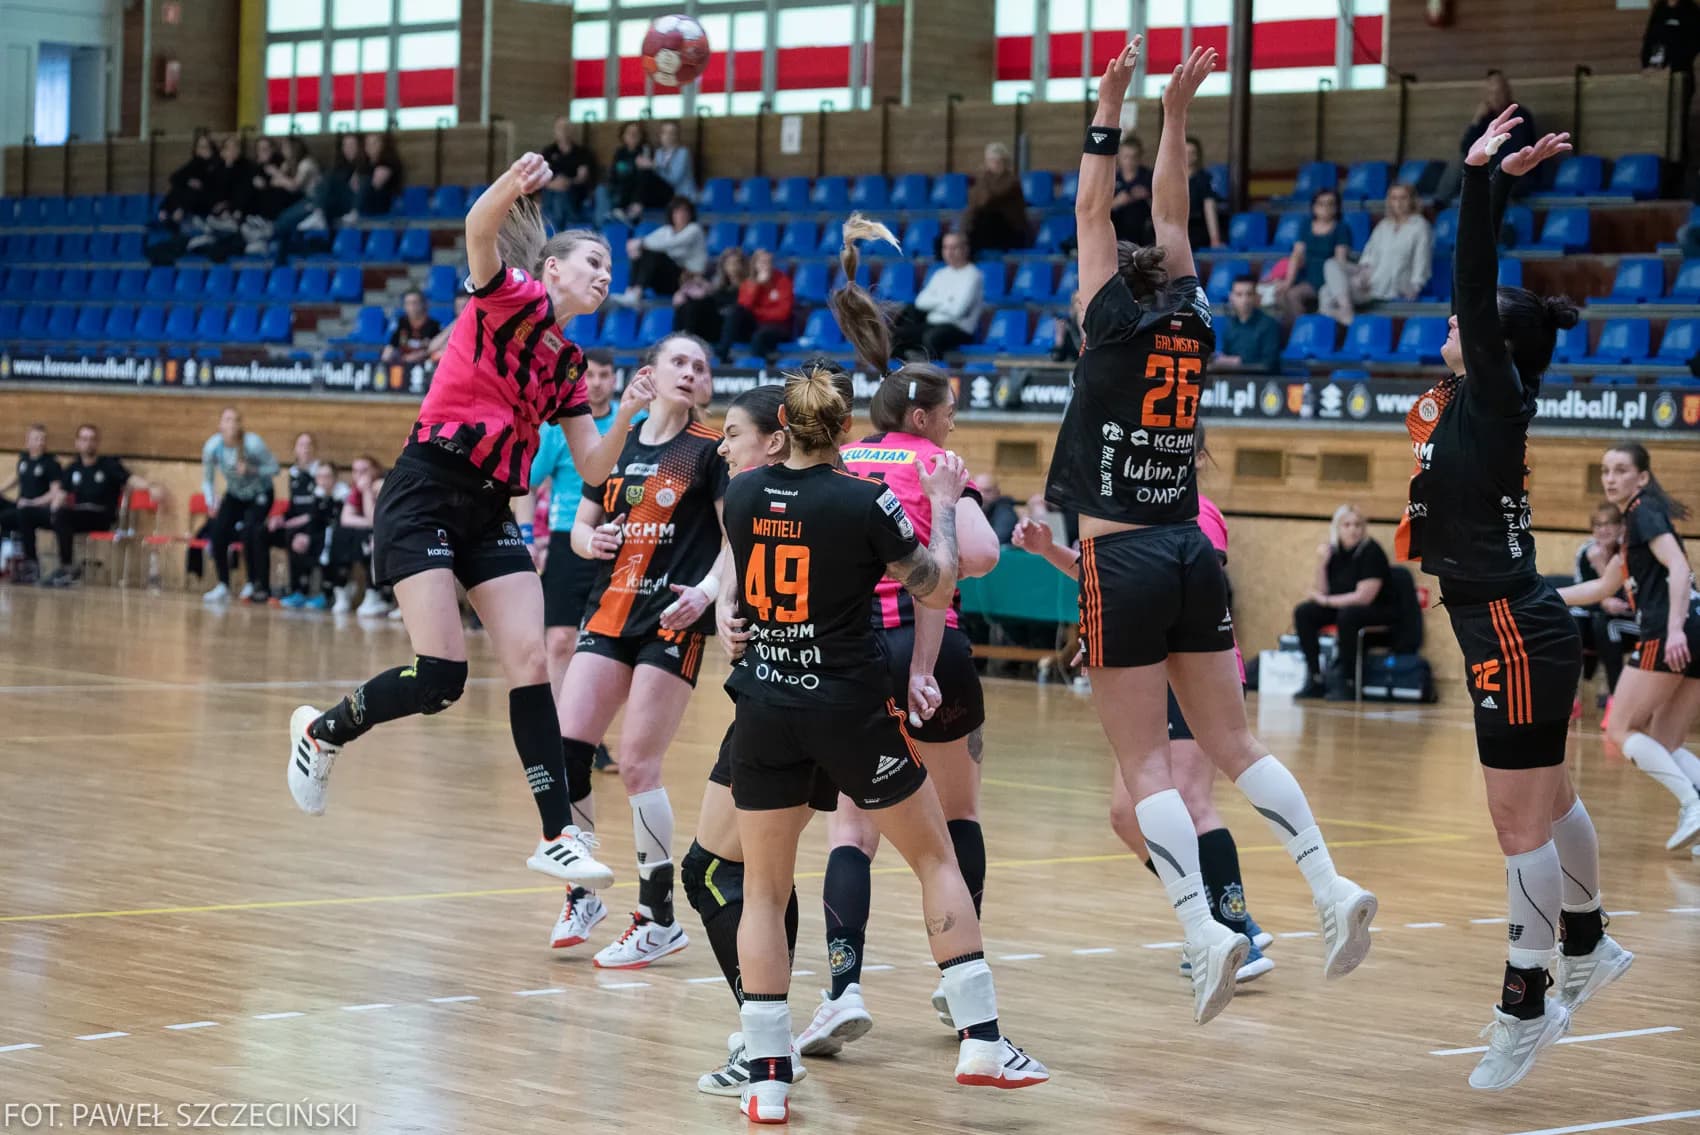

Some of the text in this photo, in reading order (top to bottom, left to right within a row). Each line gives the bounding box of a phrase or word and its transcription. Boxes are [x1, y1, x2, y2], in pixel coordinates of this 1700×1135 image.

[213, 359, 372, 392] www.koronahaball.pl
[1141, 353, 1201, 429] 26
[842, 448, 910, 461] EWIATAN
[753, 516, 802, 539] MATIELI
[745, 543, 810, 623] 49
